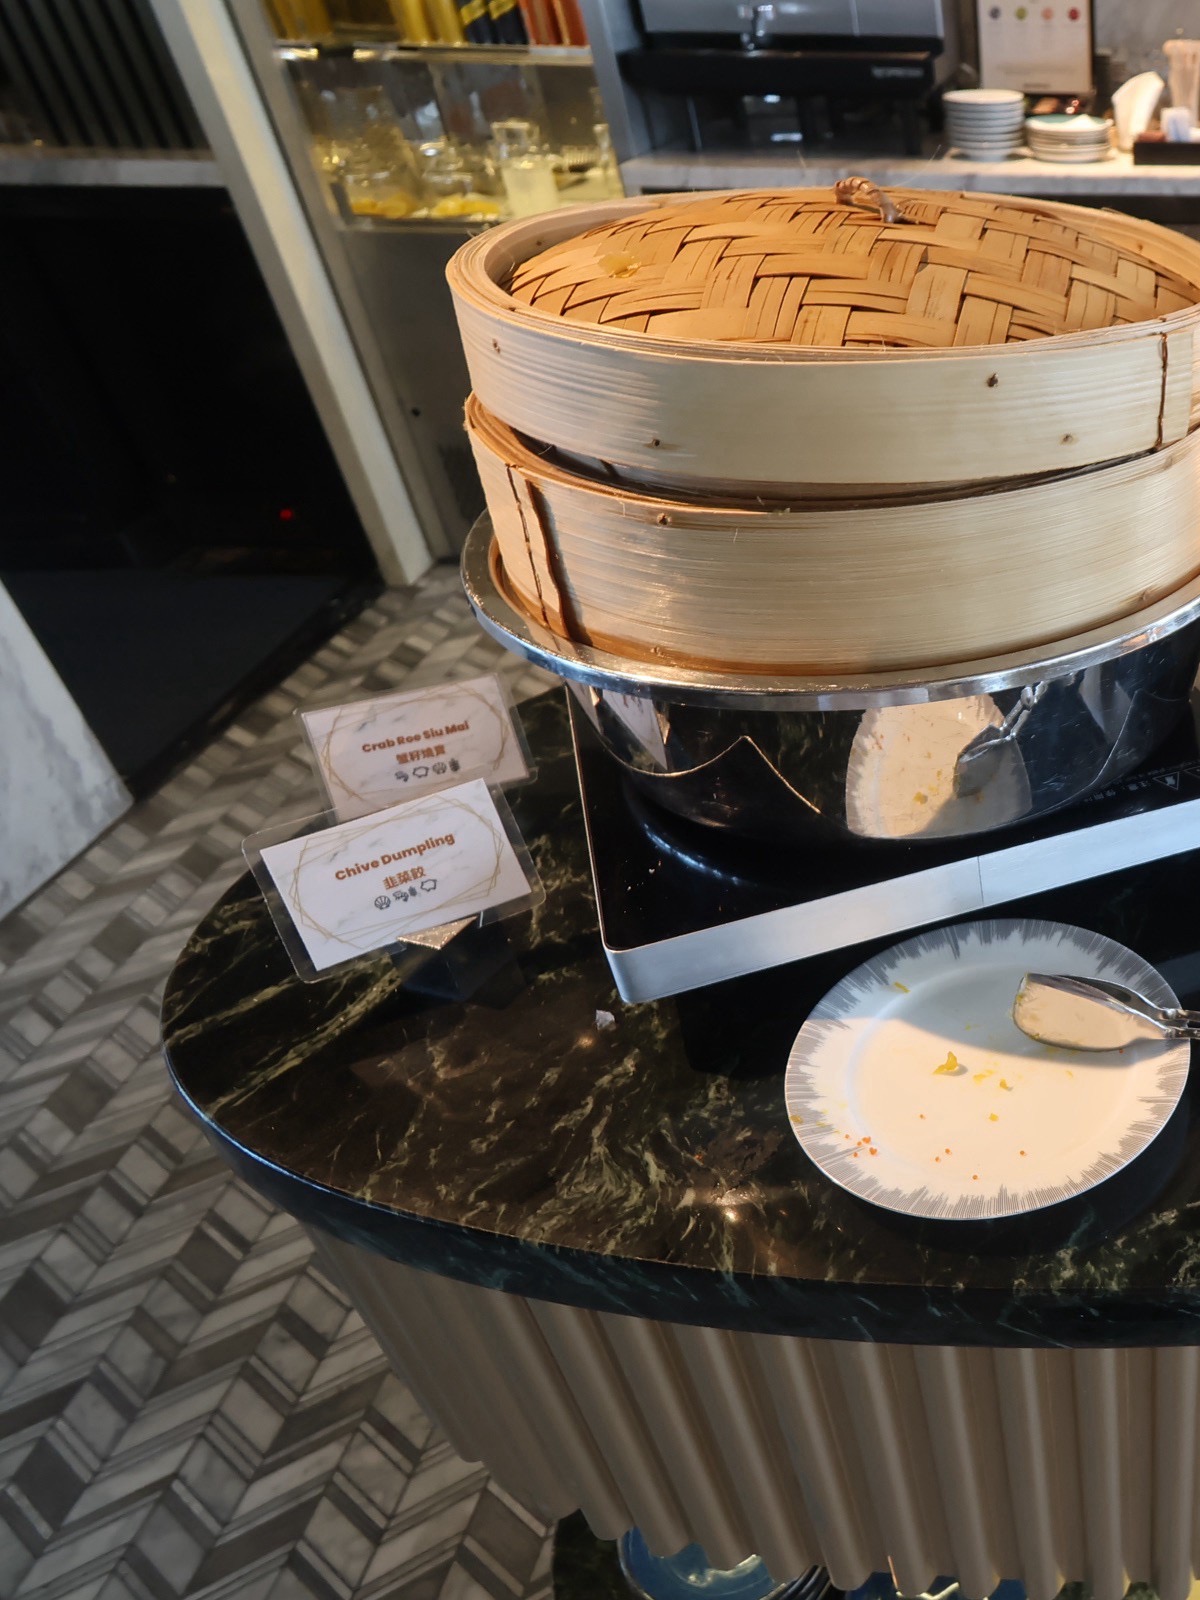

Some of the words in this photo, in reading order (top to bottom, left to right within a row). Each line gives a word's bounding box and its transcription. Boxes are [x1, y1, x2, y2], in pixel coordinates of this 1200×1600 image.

[361, 739, 395, 753] Crab
[396, 732, 422, 746] Roe
[423, 726, 444, 740] Siu
[445, 720, 470, 736] Mai
[335, 857, 380, 881] Chive
[381, 833, 456, 866] Dumpling
